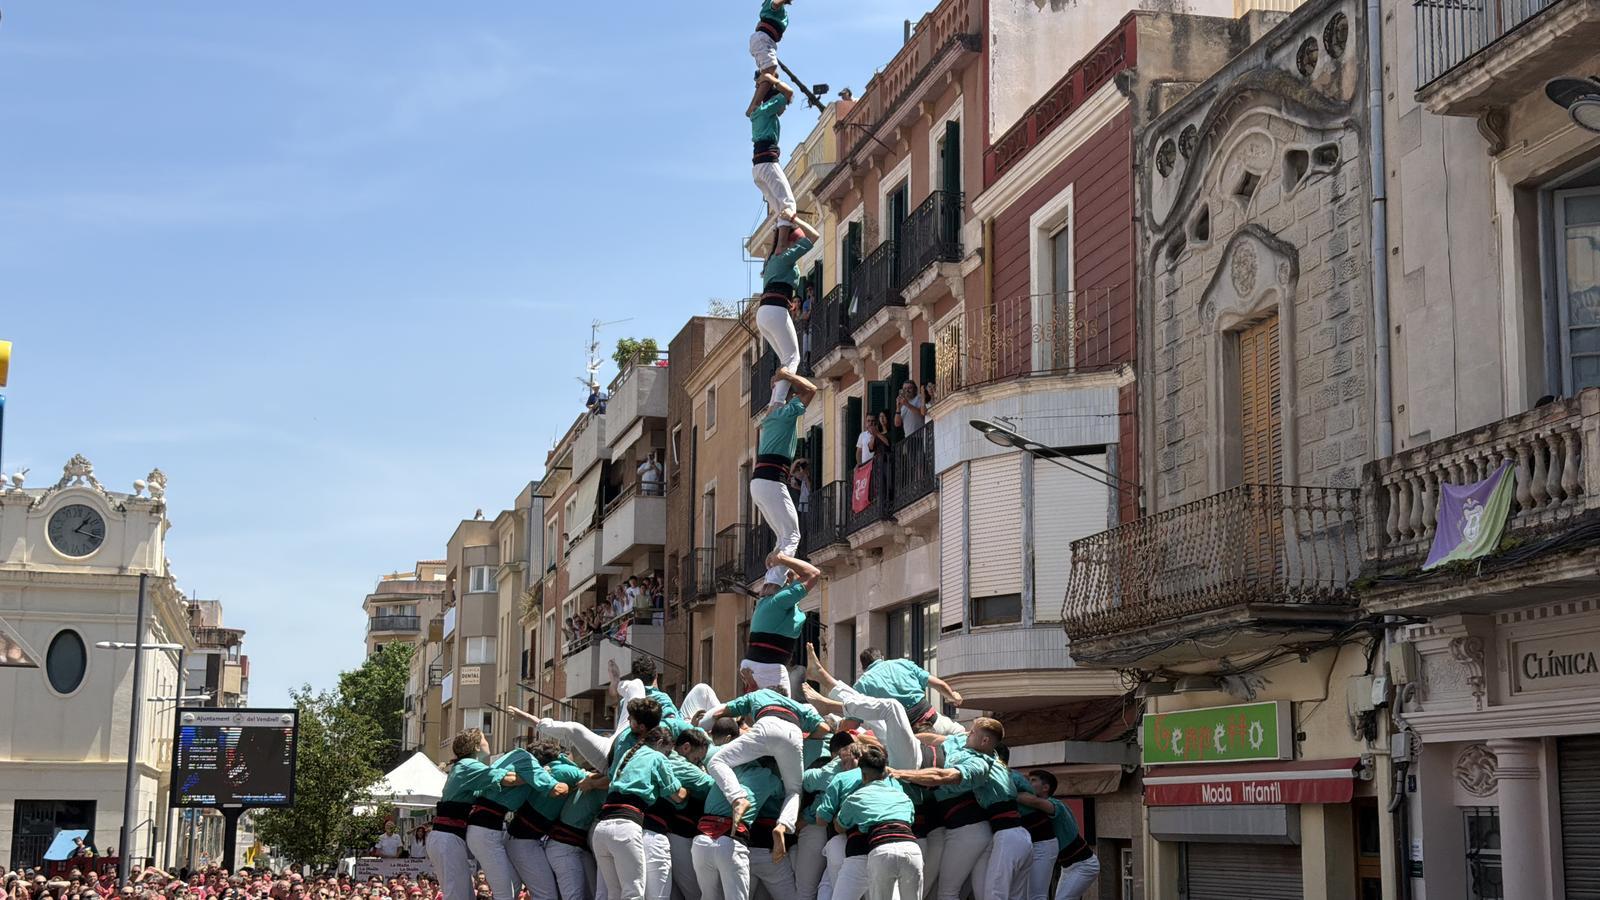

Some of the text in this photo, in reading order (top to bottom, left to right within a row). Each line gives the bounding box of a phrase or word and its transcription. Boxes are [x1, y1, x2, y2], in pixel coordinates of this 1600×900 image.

[1523, 650, 1599, 679] CLÍNICA
[1154, 711, 1264, 760] Geppetto
[1201, 781, 1281, 803] Moda Infantil
